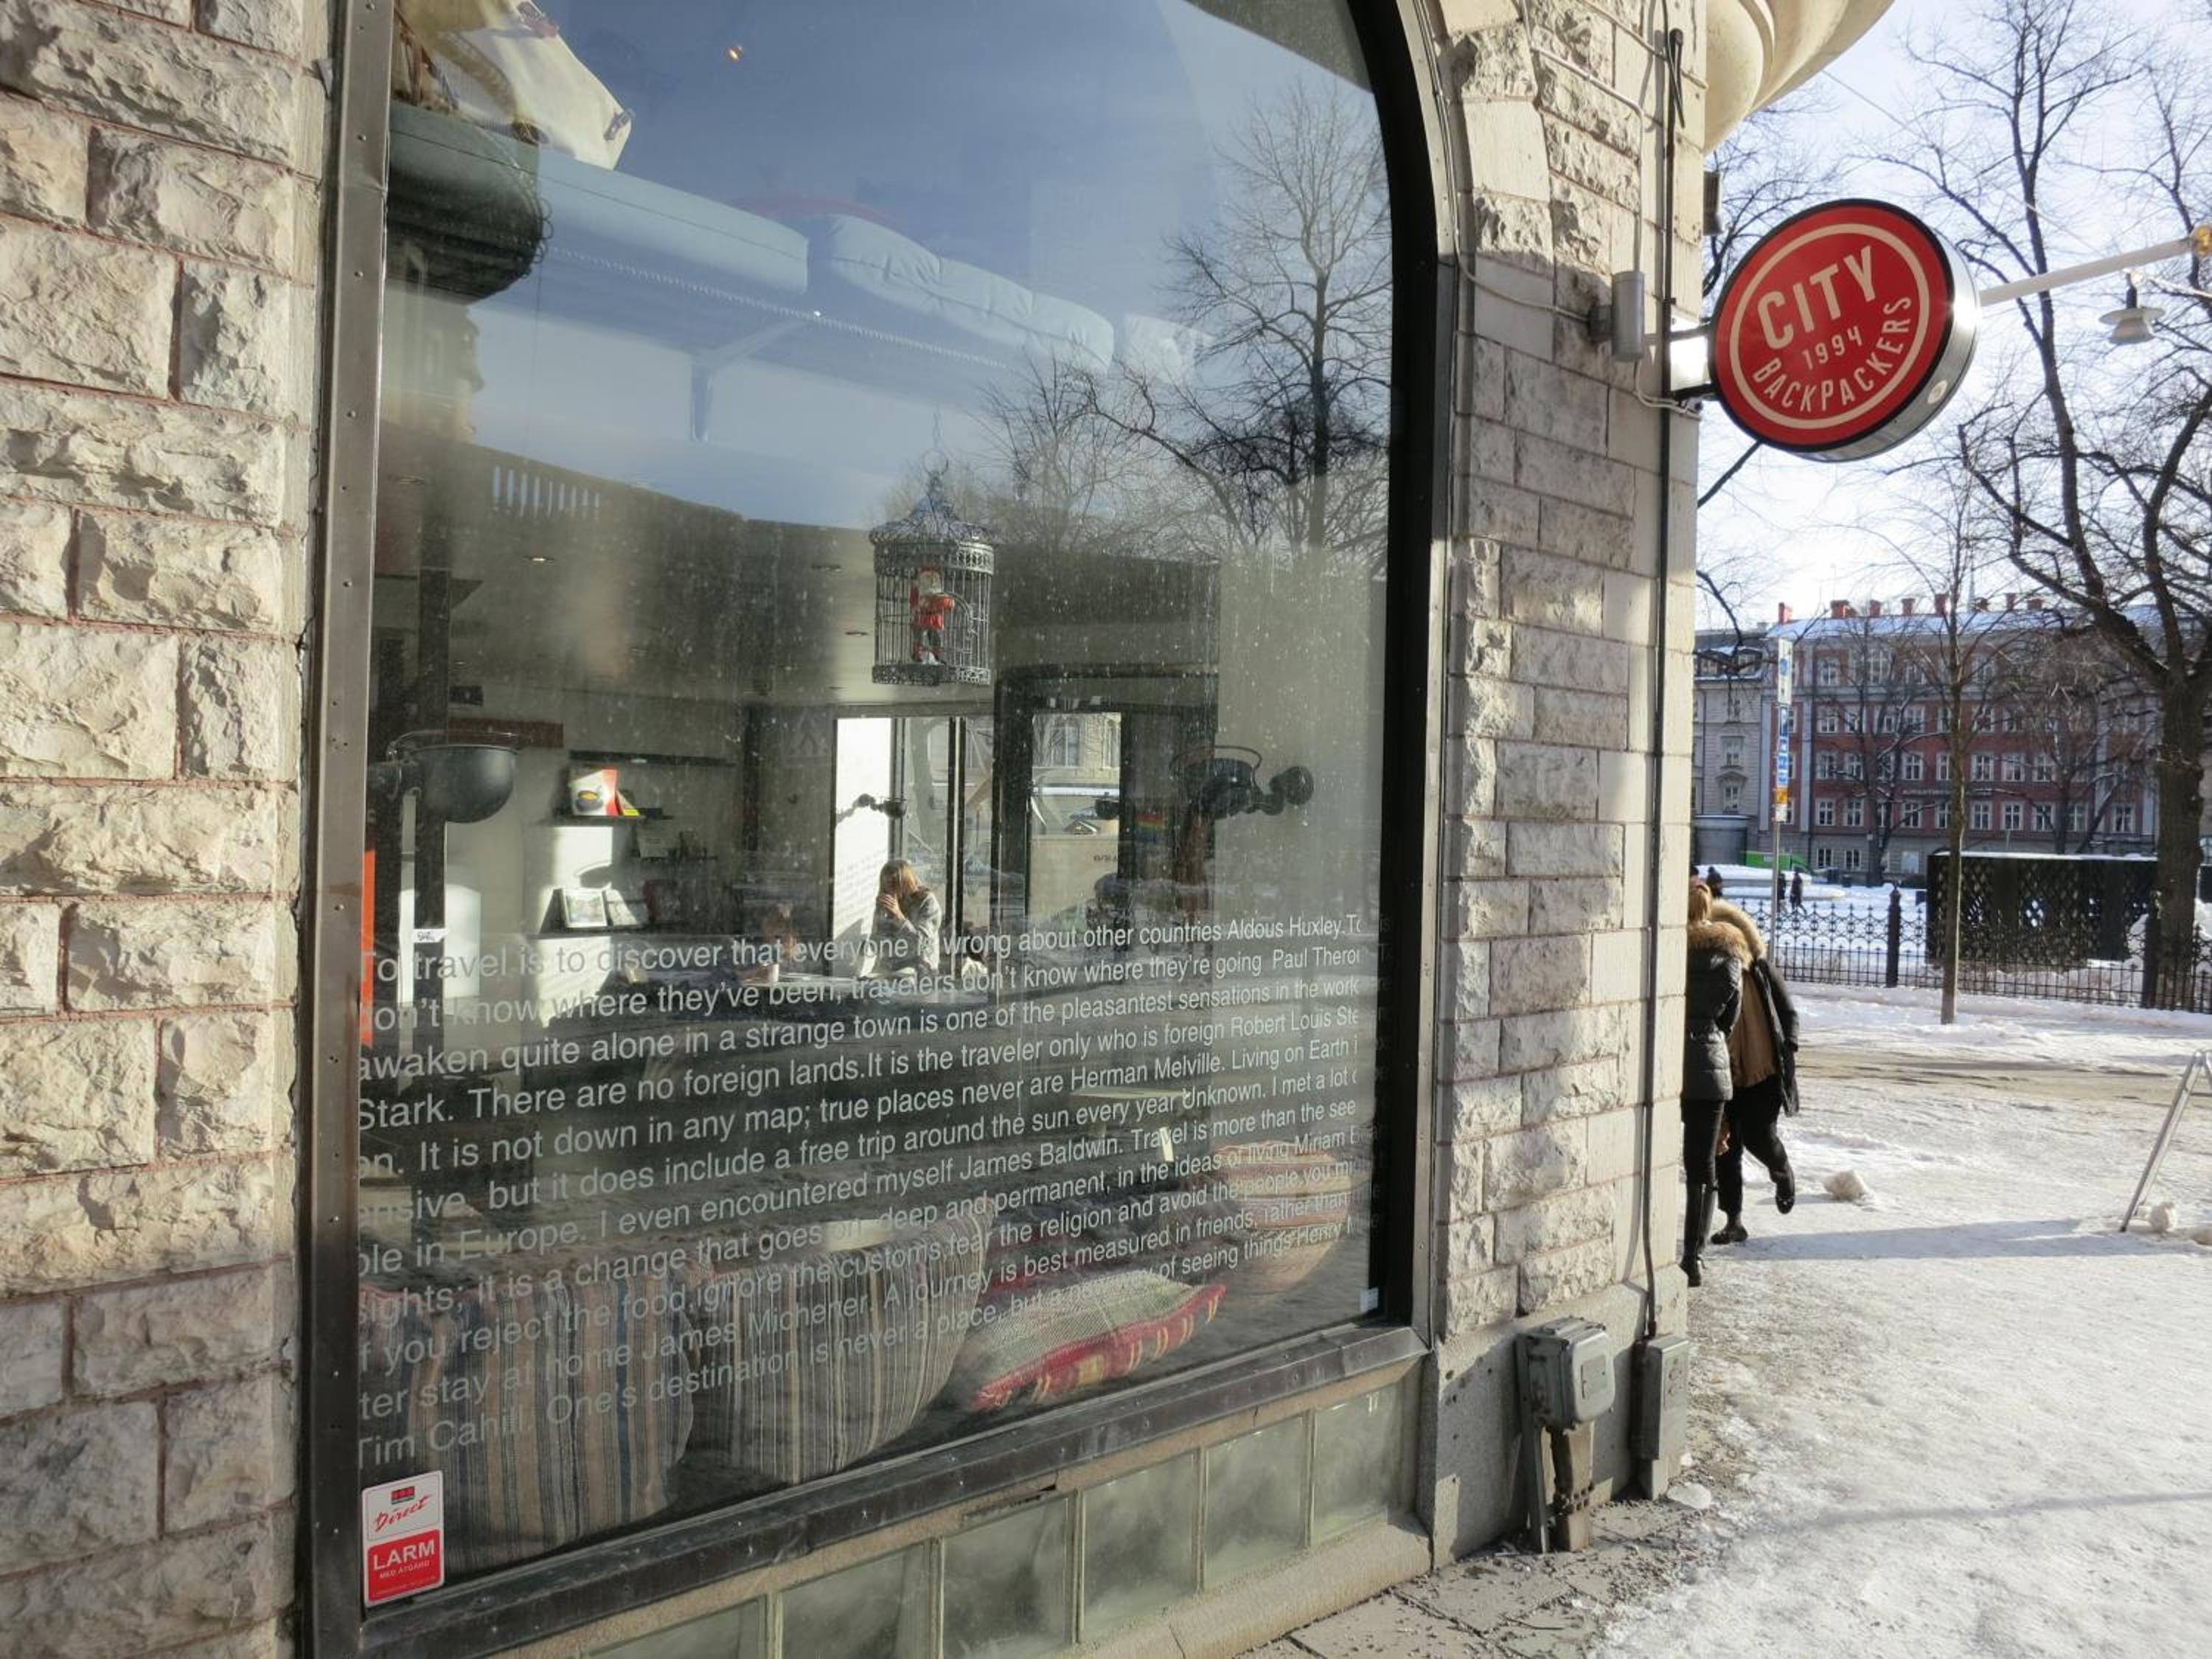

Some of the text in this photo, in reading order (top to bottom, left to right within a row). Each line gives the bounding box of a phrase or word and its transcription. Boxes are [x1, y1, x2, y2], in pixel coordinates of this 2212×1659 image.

[1753, 296, 1912, 413] BACKPACKERS
[1757, 246, 1876, 350] CITY
[1802, 325, 1863, 369] 1994
[413, 918, 1284, 981] travel is to discover that everyone wrong about other countries Aldous
[552, 988, 647, 1020] where
[658, 981, 759, 1018] they've
[768, 977, 841, 1005] been,
[852, 970, 955, 999] travelers
[962, 964, 1016, 991] don't
[1024, 963, 1077, 987] know
[1084, 959, 1143, 983] where
[1150, 953, 1210, 983] they're
[1215, 951, 1262, 980] going
[1273, 947, 1307, 970] Paul
[358, 978, 1318, 1082] awaken quite alone in a strange town is one of the pleasantest sensations in the
[358, 1008, 1330, 1131] Stark. There are no foreign is the traveler only who is foreign Robert Louis
[420, 1036, 1349, 1172] It is not down in any map; true places never are Herman Melville. Living on Earth
[489, 1175, 540, 1211] but
[552, 1171, 568, 1201] it
[580, 1164, 654, 1197] does
[664, 1146, 765, 1185] include
[775, 1146, 790, 1169] a
[799, 1138, 849, 1166] free
[858, 1128, 896, 1161] trip
[904, 1115, 984, 1150] around
[992, 1111, 1025, 1138] the
[1032, 1108, 1068, 1132] sun
[1076, 1100, 1129, 1126] every
[1135, 1093, 1174, 1124] year
[1181, 1082, 1266, 1110] Unknown.
[1272, 1076, 1276, 1097] I
[1282, 1072, 1311, 1096] met
[1315, 1074, 1325, 1091] a
[1329, 1067, 1348, 1088] lot
[417, 1099, 1356, 1268] in Europe. I even encountered myself James Baldwin. Travel is more than the see
[479, 1273, 495, 1304] it
[508, 1267, 532, 1298] is
[543, 1266, 562, 1293] a
[574, 1245, 686, 1287] change
[696, 1229, 750, 1265] that
[758, 1221, 822, 1262] goes
[879, 1201, 937, 1231] deep
[945, 1188, 987, 1219] and
[995, 1169, 1110, 1217] permanent,
[1118, 1164, 1133, 1188] in
[1140, 1158, 1169, 1183] the
[1175, 1152, 1222, 1178] ideas
[1294, 1130, 1345, 1155] Miriam
[358, 1221, 1190, 1422] ter stay at home James Michener. A journey is best measured in
[383, 1179, 1237, 1379] you reject the the the religion and avoid the
[358, 1433, 414, 1470] Tim
[547, 1380, 637, 1425] One's
[649, 1345, 799, 1401] destination
[810, 1335, 829, 1363] is
[839, 1321, 906, 1356] never
[1160, 1254, 1176, 1280] of
[1181, 1245, 1237, 1275] seeing
[1244, 1233, 1290, 1260] things
[373, 1539, 435, 1571] LARM
[374, 1494, 433, 1533] Direct
